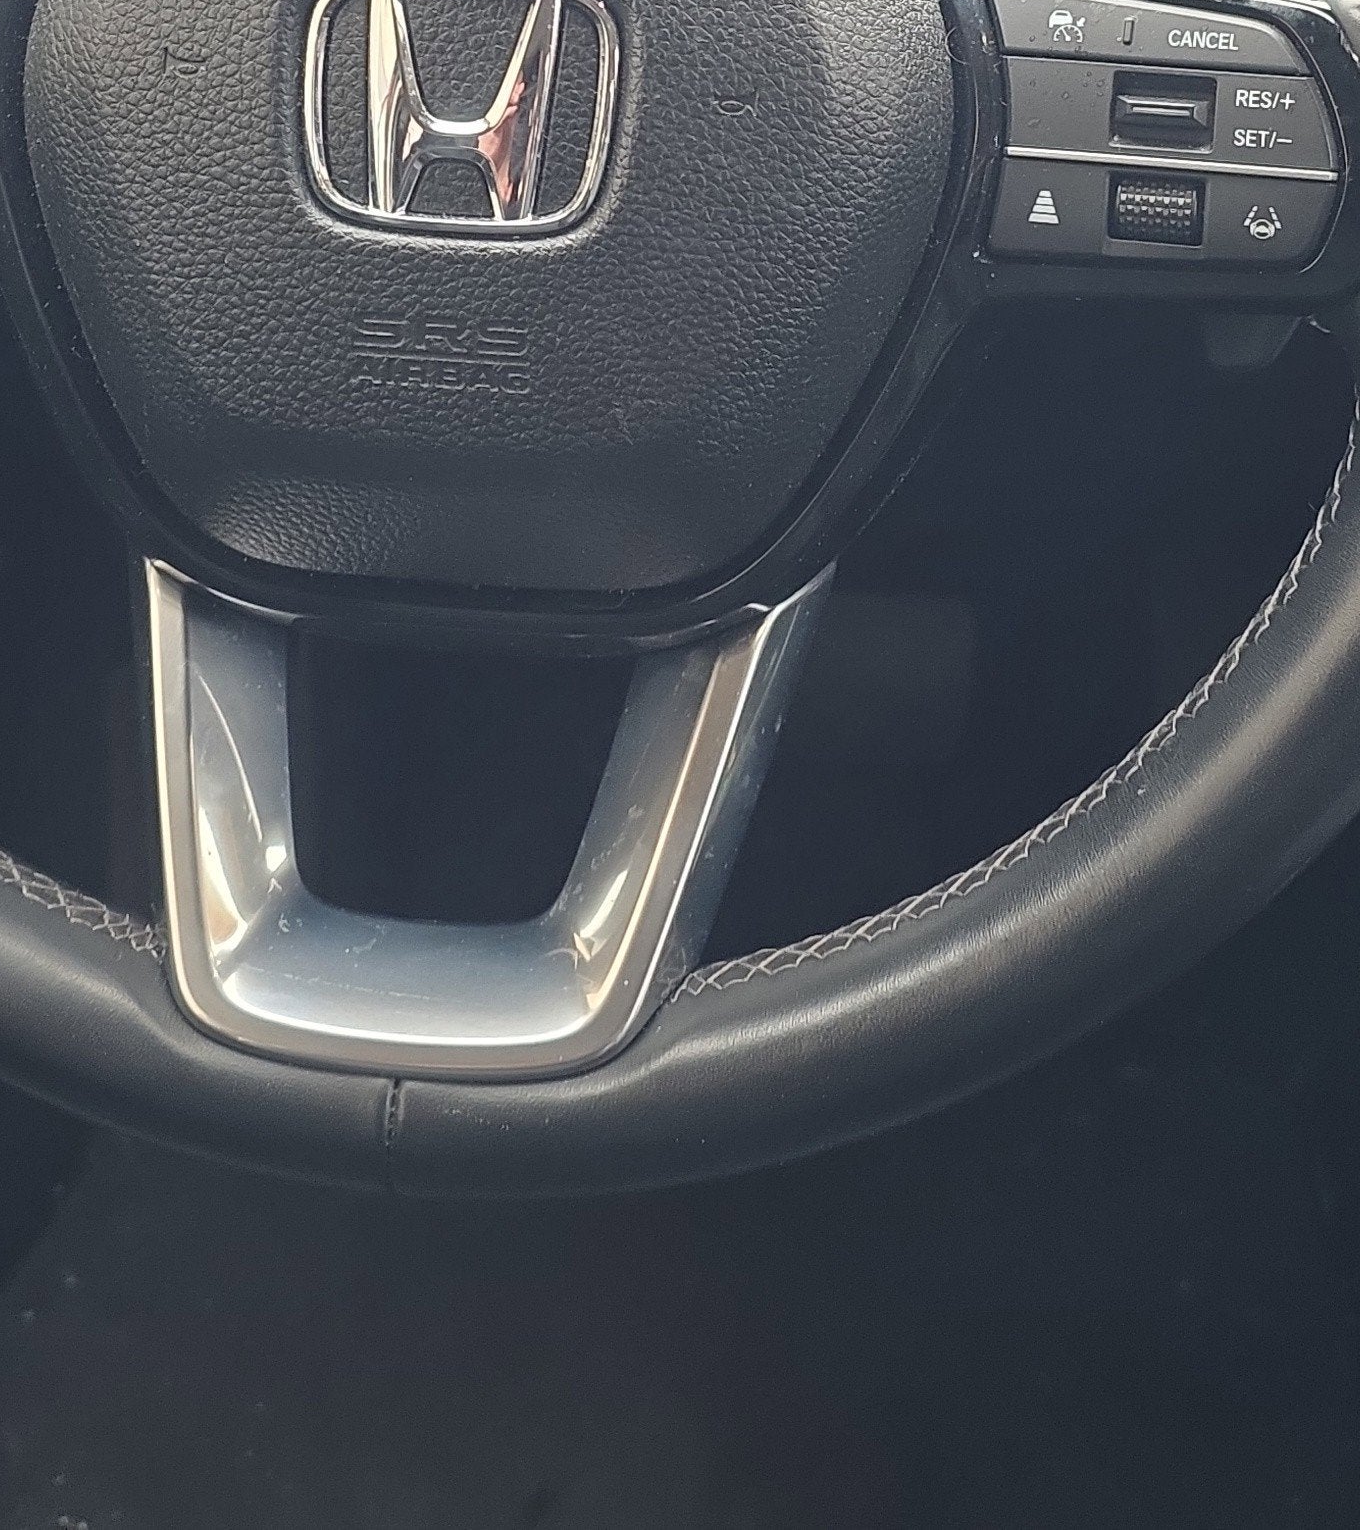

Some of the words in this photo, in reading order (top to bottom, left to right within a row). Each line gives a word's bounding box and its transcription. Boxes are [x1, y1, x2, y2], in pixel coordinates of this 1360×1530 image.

[1168, 29, 1239, 51] CANCEL
[1236, 89, 1296, 111] RES/+
[354, 319, 529, 355] SRS
[352, 362, 530, 395] AIRBAG
